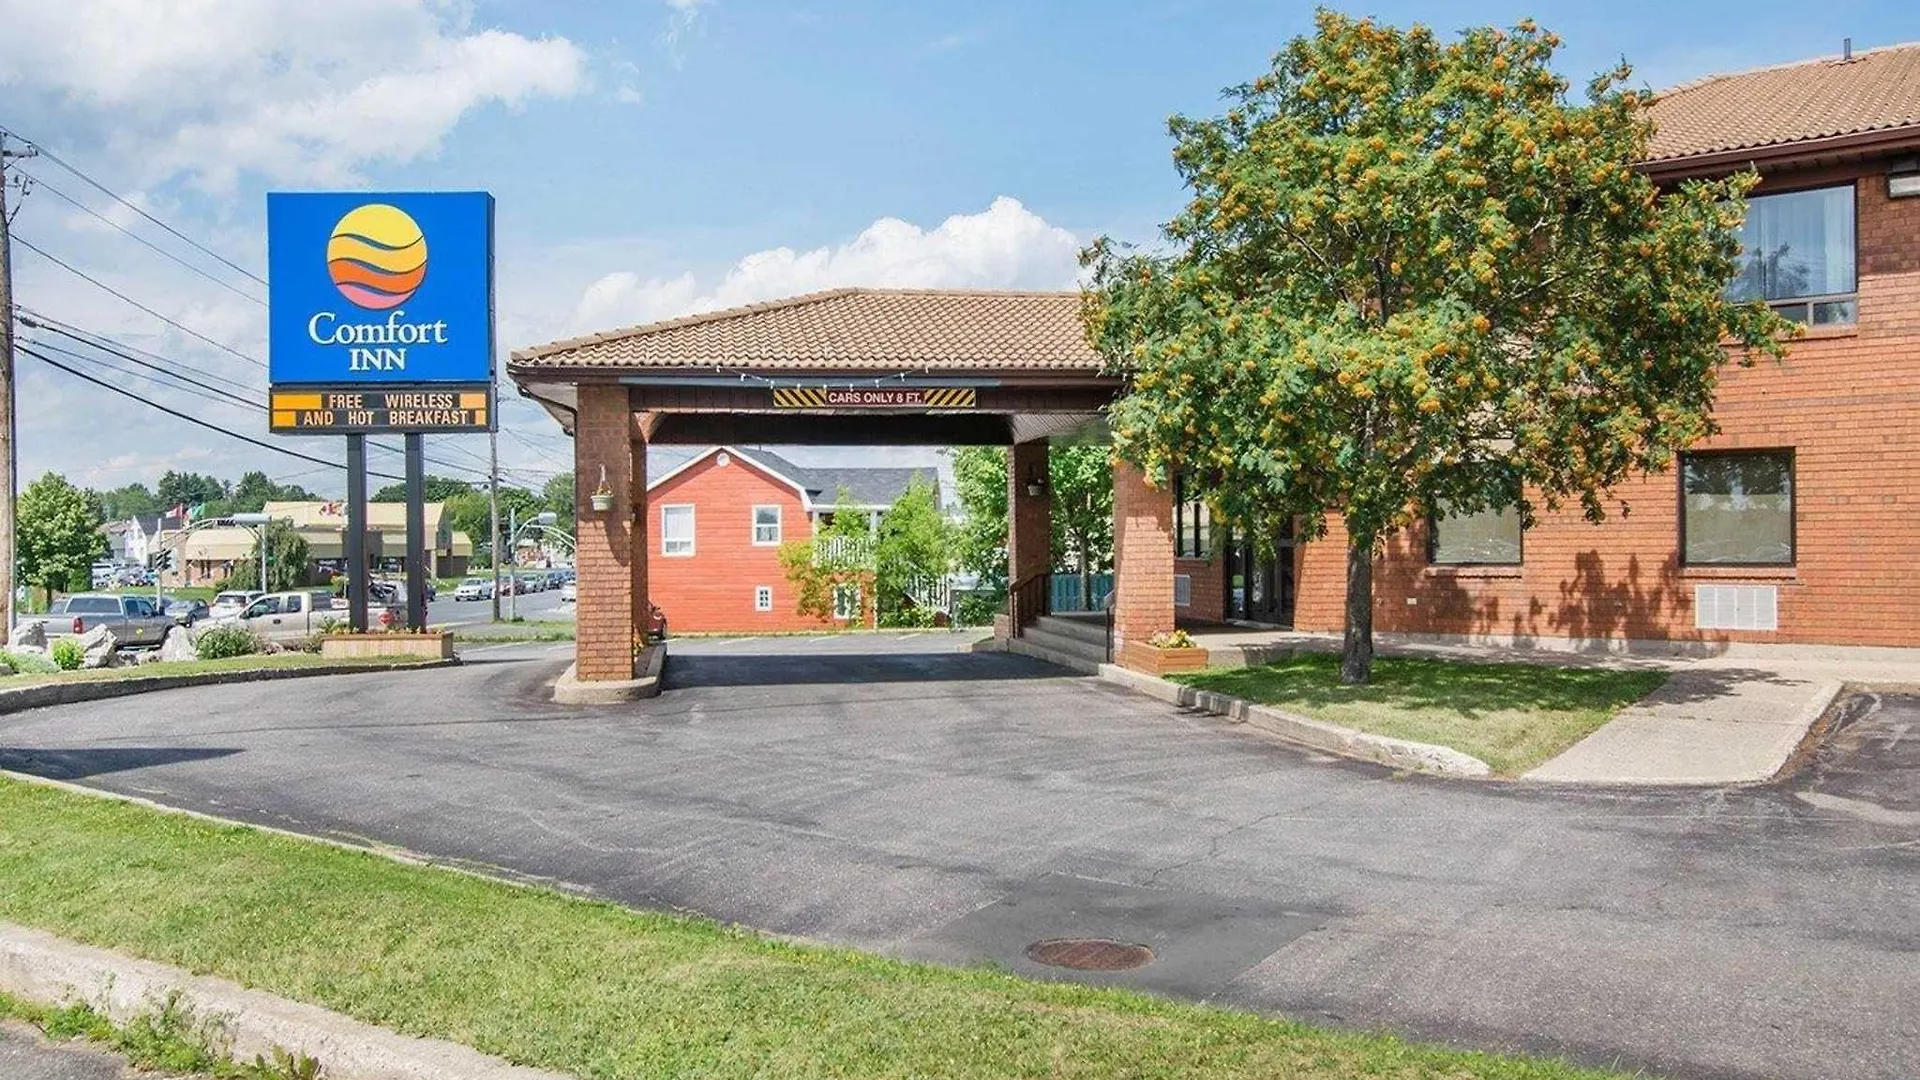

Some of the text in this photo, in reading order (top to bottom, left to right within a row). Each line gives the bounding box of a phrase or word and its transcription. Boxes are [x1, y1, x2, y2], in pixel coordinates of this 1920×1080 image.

[308, 311, 448, 344] Comfort
[349, 348, 406, 371] INN
[329, 393, 453, 409] FREE WIRELESS
[828, 392, 861, 403] CARS
[863, 392, 894, 403] ONLY
[906, 392, 922, 403] FT.
[303, 411, 467, 426] AND HOT BREAKFAST
